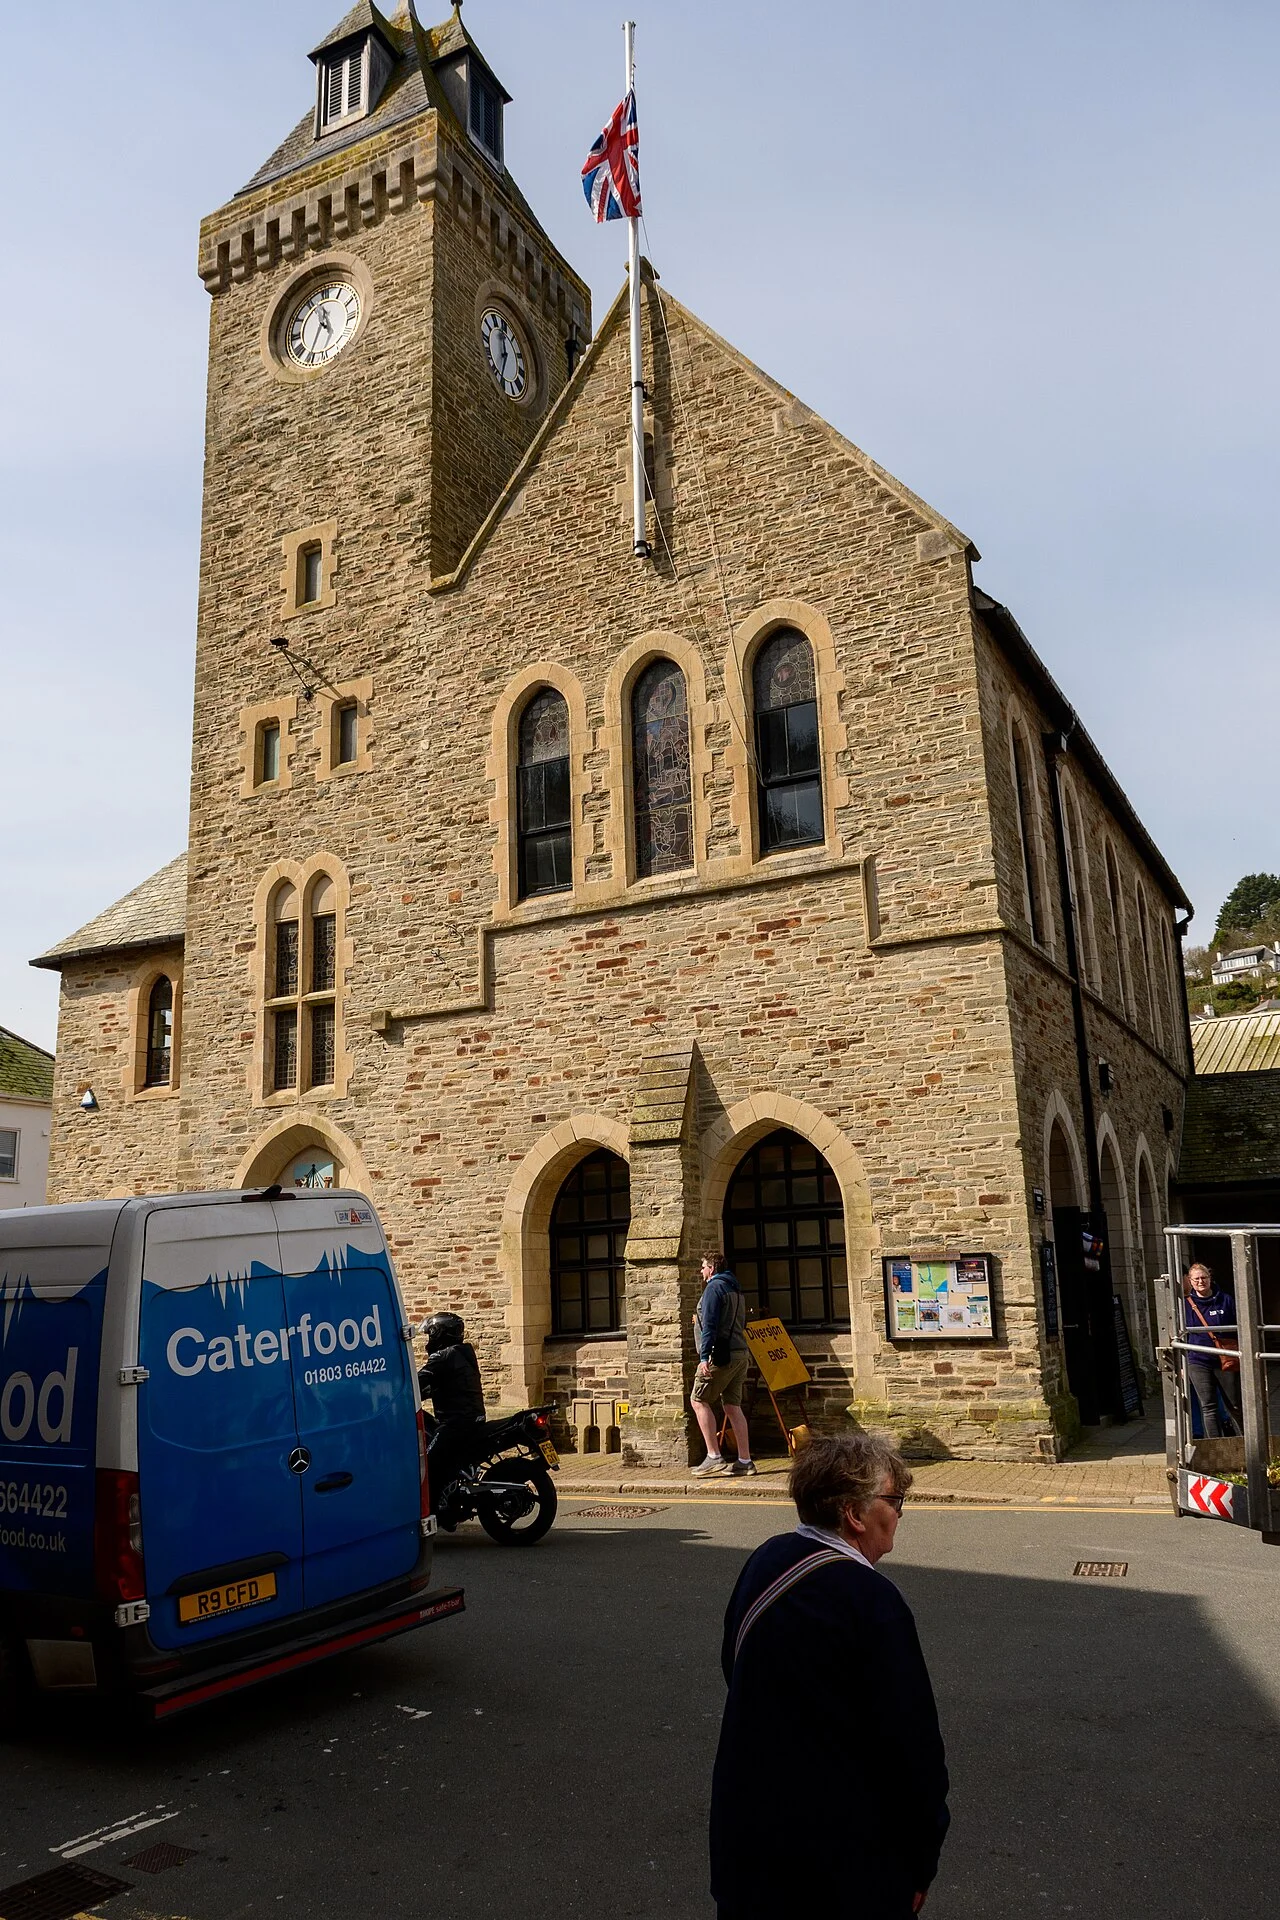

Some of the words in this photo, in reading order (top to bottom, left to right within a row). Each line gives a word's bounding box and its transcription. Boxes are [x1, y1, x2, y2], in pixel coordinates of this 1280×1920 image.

[166, 1304, 383, 1377] Caterfood
[745, 1323, 783, 1341] Diversion
[767, 1347, 788, 1362] ENDS
[304, 1365, 342, 1386] 01803
[345, 1357, 387, 1378] 664422
[0, 1523, 67, 1553] ood.co.uk
[198, 1591, 221, 1615] R9
[225, 1580, 259, 1607] CFD
